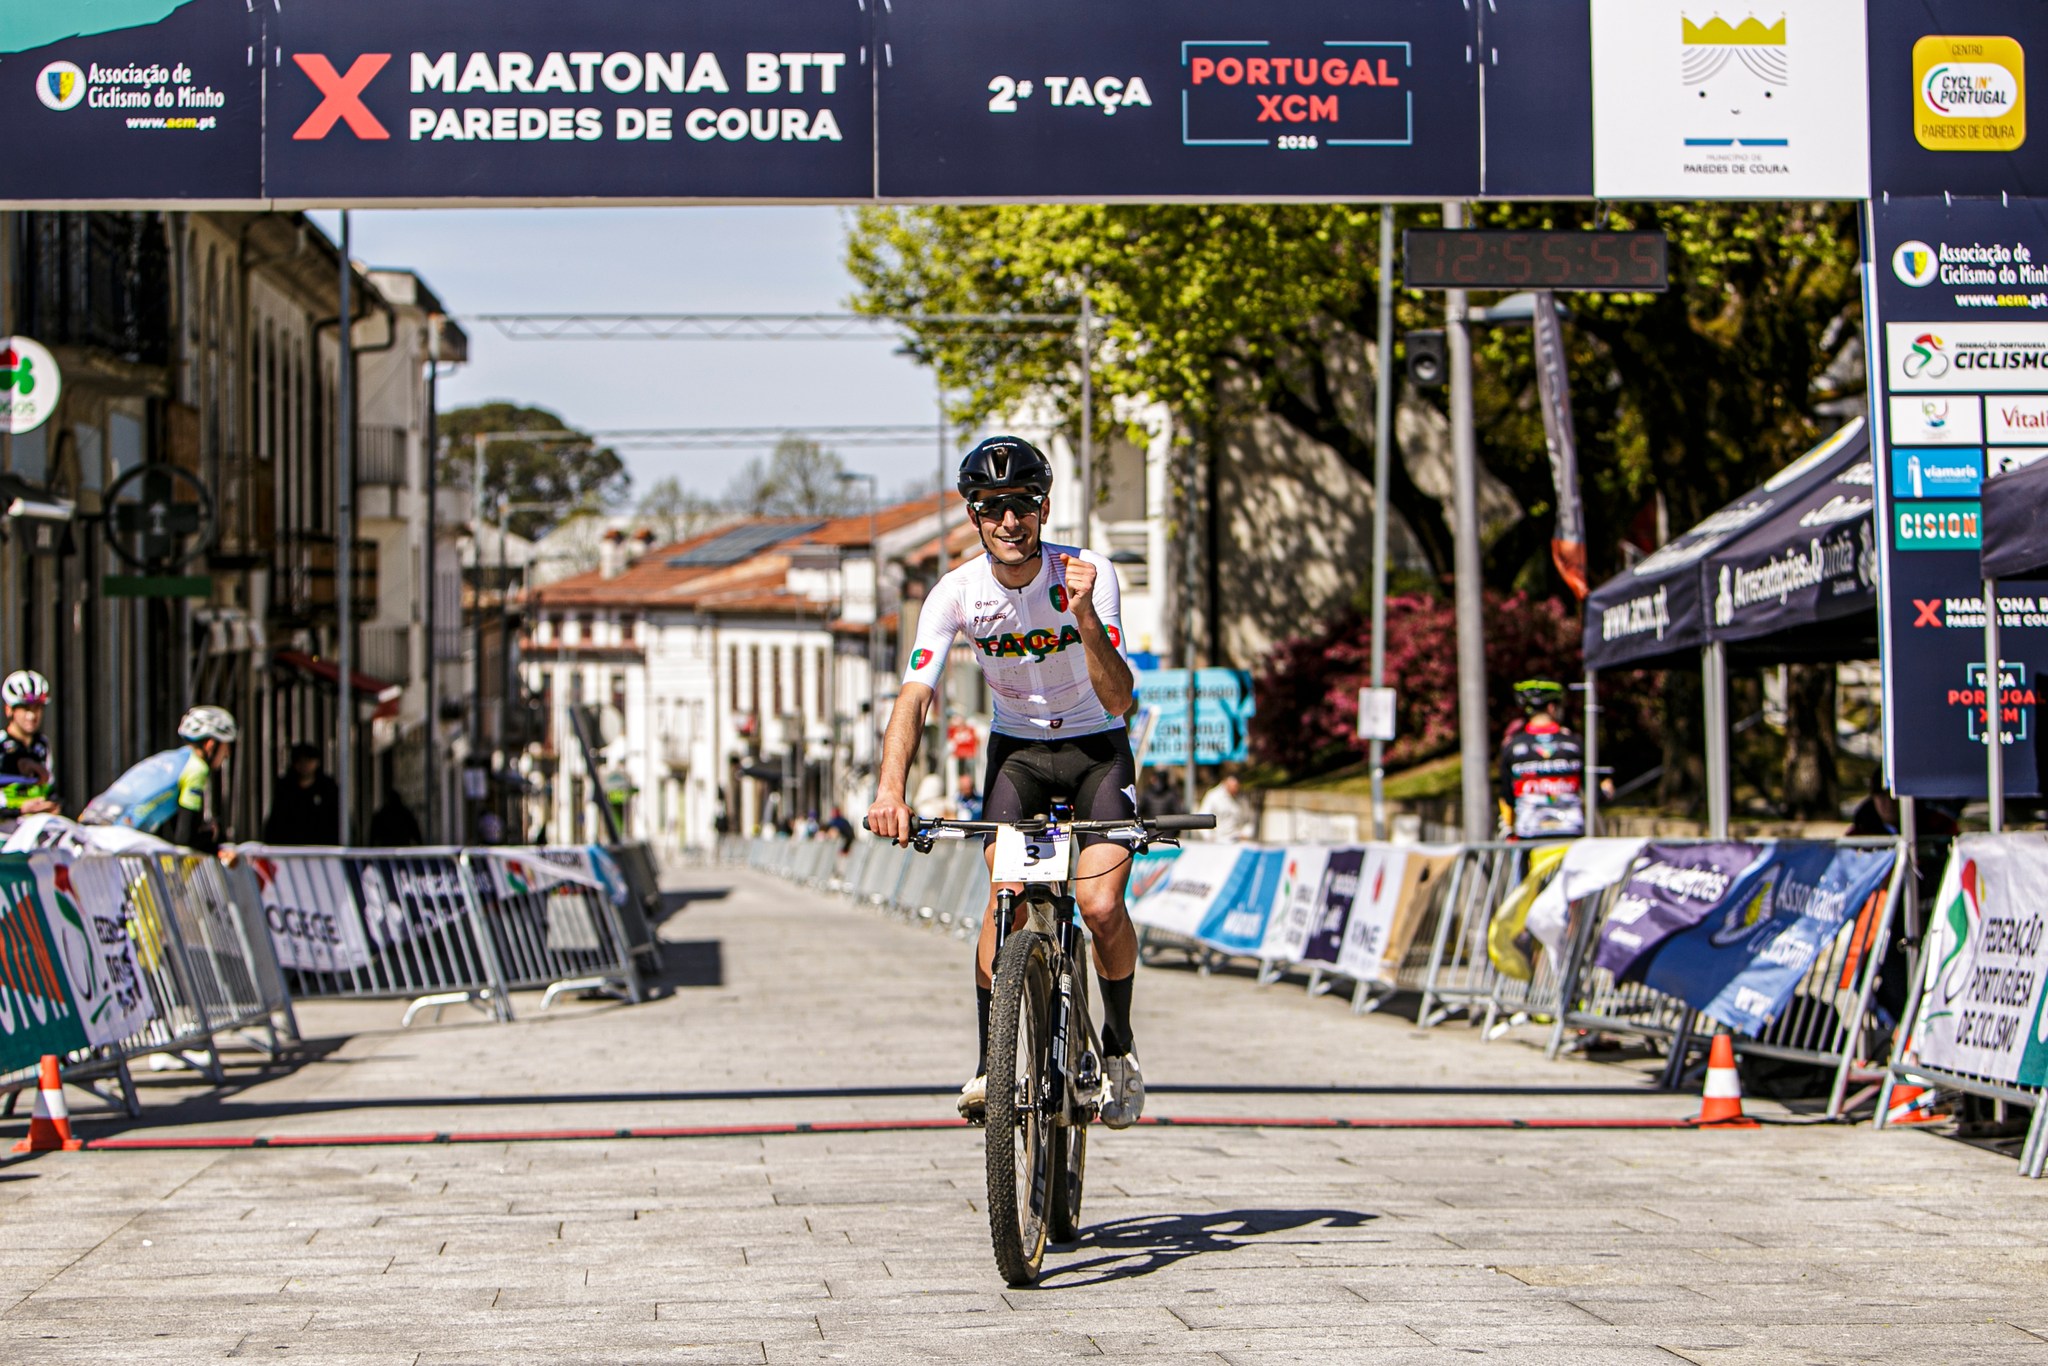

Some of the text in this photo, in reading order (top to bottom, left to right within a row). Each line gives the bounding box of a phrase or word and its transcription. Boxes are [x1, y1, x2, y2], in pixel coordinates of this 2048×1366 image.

[1951, 44, 1983, 56] CENTRO
[88, 62, 191, 89] Associação de
[410, 52, 846, 93] MARATONA BTT
[1192, 57, 1399, 86] PORTUGAL
[88, 86, 225, 108] Ciclismo do Minho
[292, 53, 391, 139] X
[1044, 76, 1152, 116] TAÇA
[1940, 90, 2007, 105] PORTUGAL
[1256, 95, 1339, 122] XCM
[126, 116, 216, 130] www.acm.pt
[410, 108, 842, 141] PAREDES DE COURA
[1921, 125, 2016, 139] PAREDES DE COURA
[1277, 135, 1318, 150] 2026
[1683, 164, 1790, 174] PAREDES DE COURA
[1939, 242, 2031, 268] Associação de
[1940, 264, 1997, 285] Ciclismo
[1998, 264, 2017, 285] do
[1954, 293, 2048, 309] www.acm.pt
[1955, 341, 1998, 349] FEDERAÇÃO
[1923, 464, 1978, 479] viamaris
[1900, 512, 1977, 539] CISION
[1912, 598, 1943, 628] X
[2004, 614, 2022, 627] DE
[1023, 844, 1041, 867] 3
[1983, 911, 2044, 967] FEDERAÇÃO
[1966, 965, 2036, 1008] PORTUGUESA
[1955, 1009, 2020, 1054] DE CICLISMO
